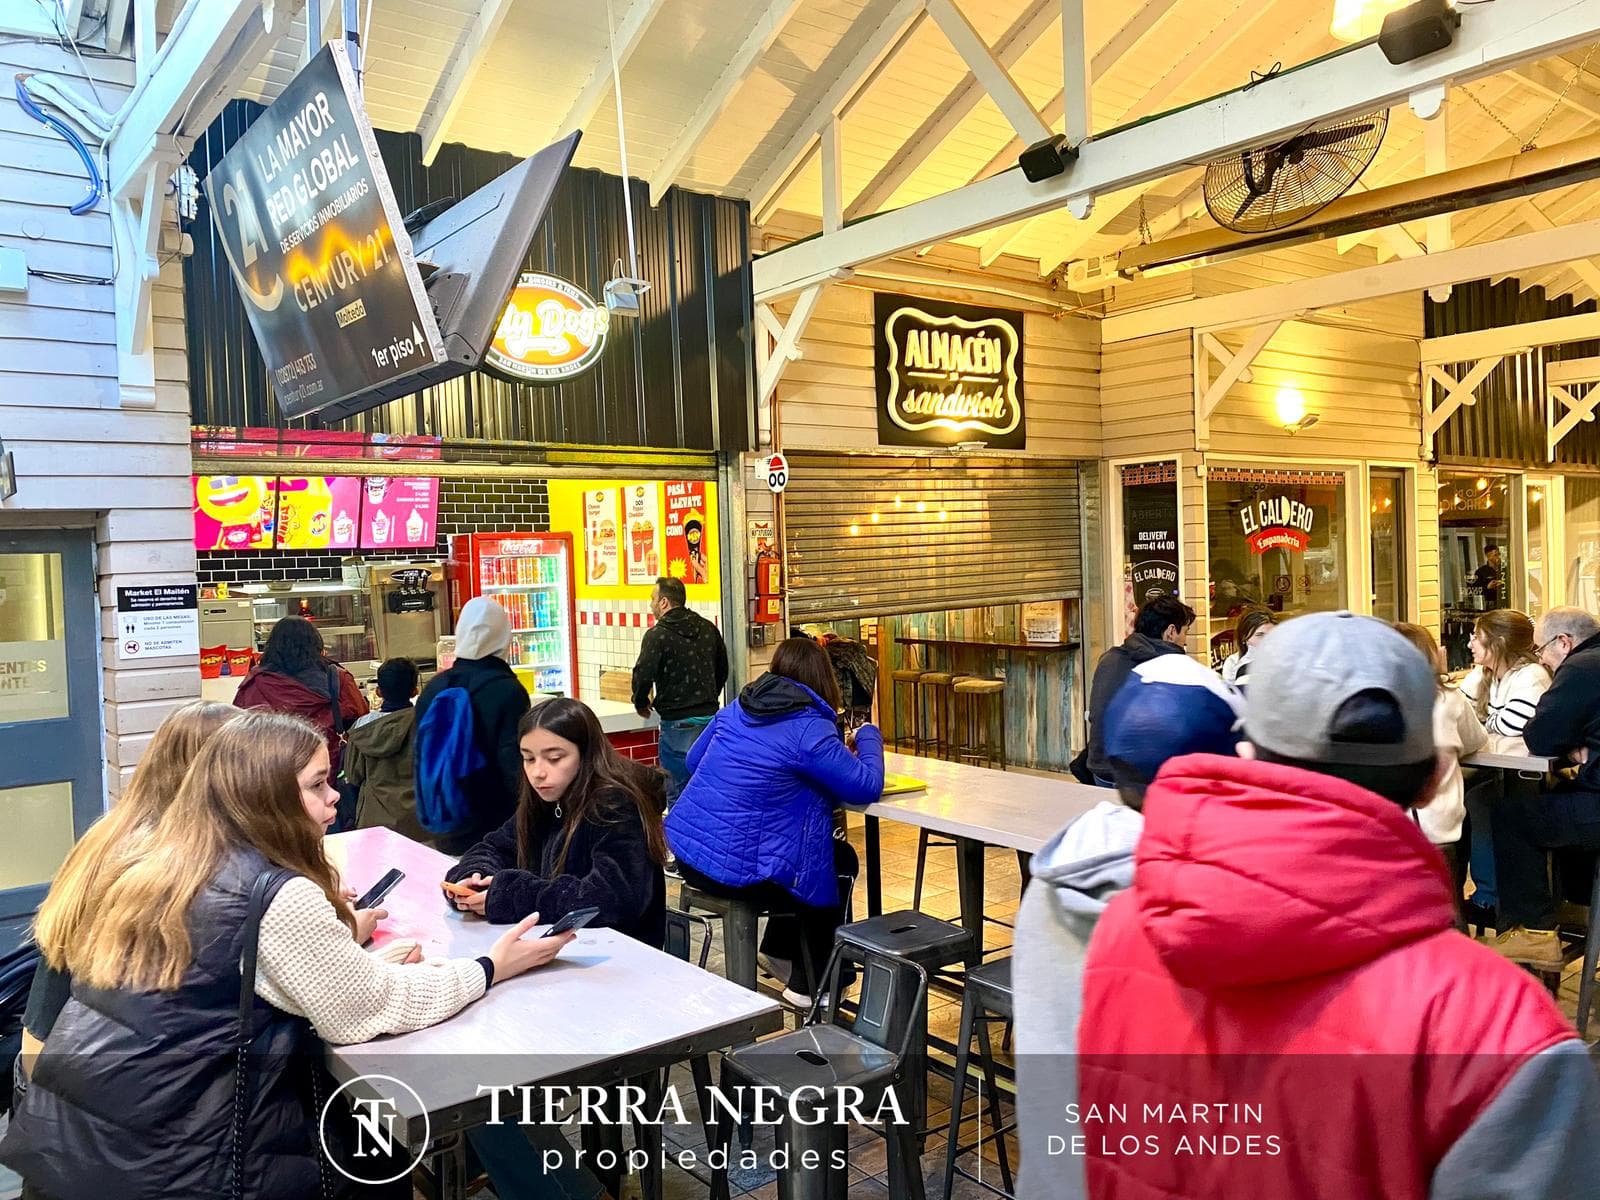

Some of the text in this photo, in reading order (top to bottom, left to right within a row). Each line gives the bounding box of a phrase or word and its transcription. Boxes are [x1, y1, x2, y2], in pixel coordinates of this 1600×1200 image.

[257, 91, 335, 182] LA MAYOR
[265, 133, 359, 231] RED GLOBAL
[279, 176, 370, 255] DE SERVICIOS INMOBILIARIOS
[293, 245, 366, 312] CENTURY
[336, 300, 366, 327] Moltedo
[536, 299, 609, 347] Dogs
[371, 335, 415, 368] 1er piso
[904, 330, 1002, 374] ALMACÉN
[902, 383, 1006, 419] sandwich
[670, 494, 703, 510] LLEVATE
[686, 482, 694, 494] Y
[666, 524, 684, 537] CONO
[1240, 496, 1314, 535] EL CALDERO
[1138, 530, 1168, 542] DELIVERY
[1148, 541, 1156, 551] 41
[1157, 541, 1166, 550] 44
[1166, 540, 1175, 550] 00
[1134, 567, 1176, 583] EL CALDERO
[124, 589, 153, 597] Market
